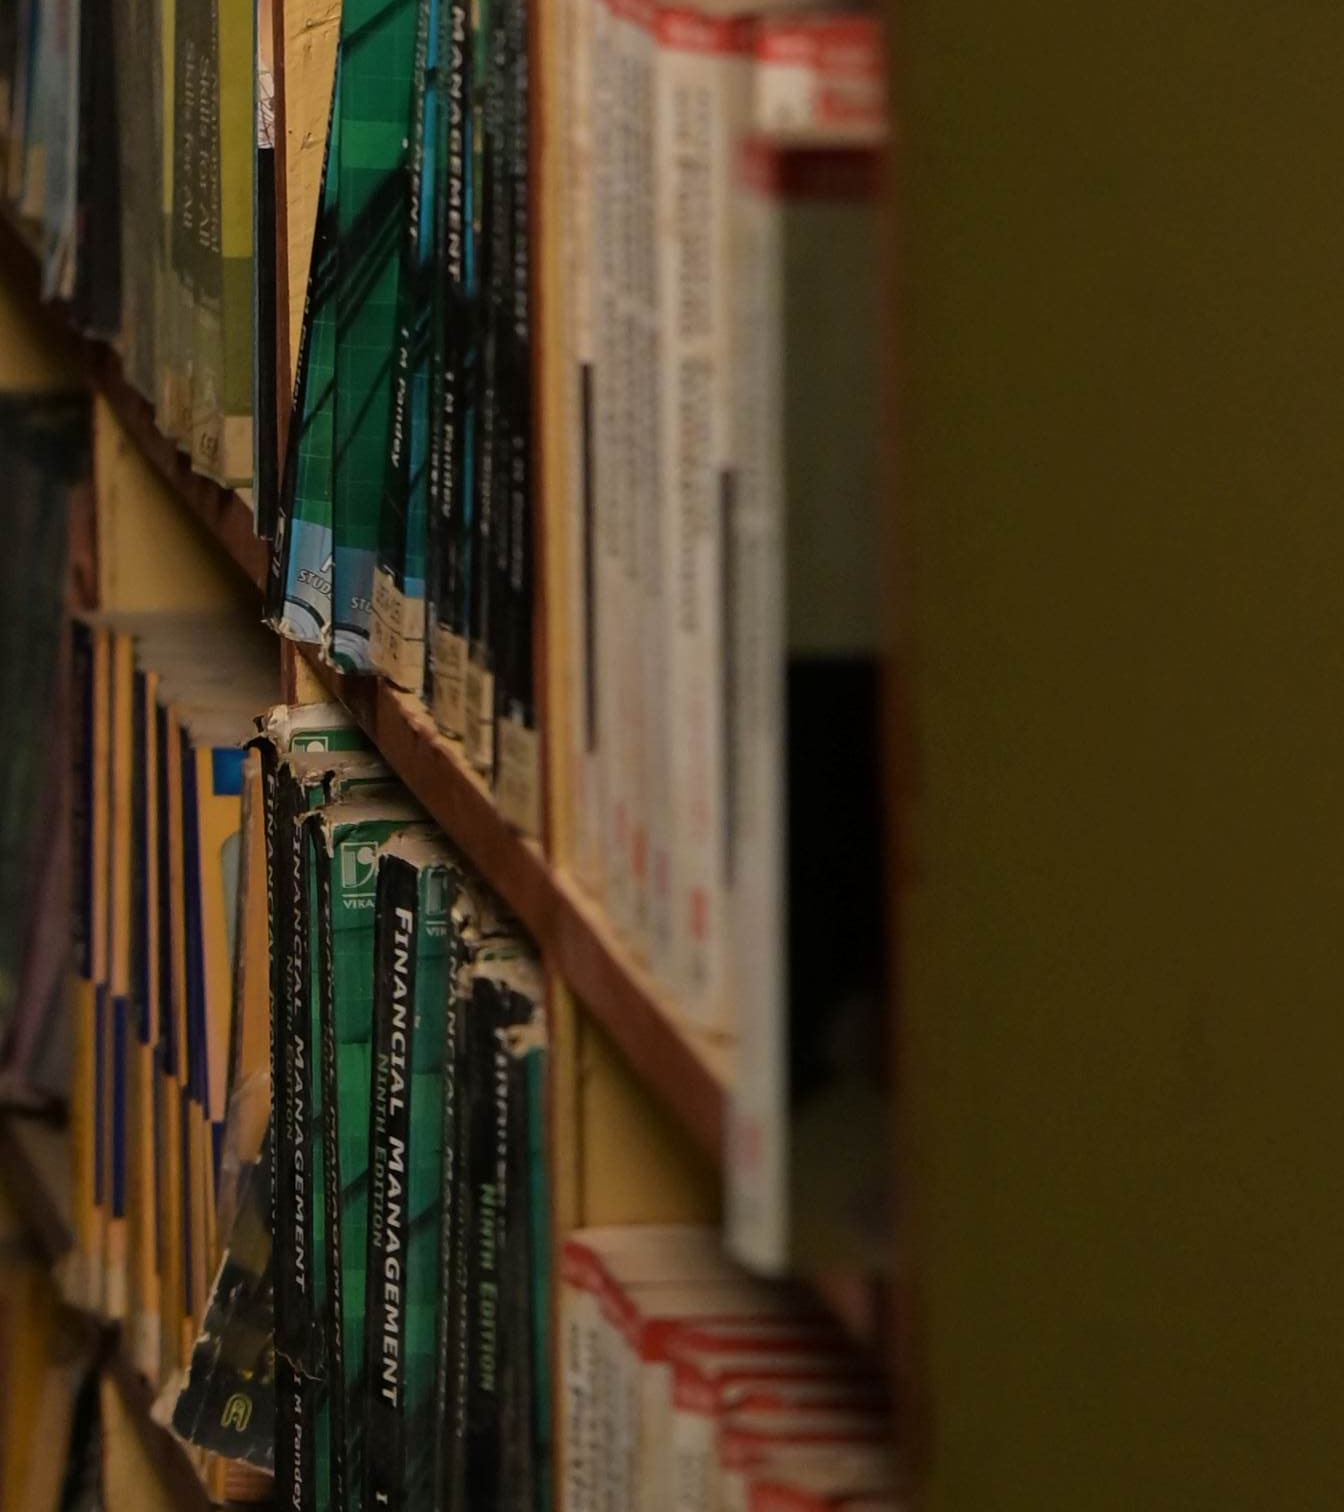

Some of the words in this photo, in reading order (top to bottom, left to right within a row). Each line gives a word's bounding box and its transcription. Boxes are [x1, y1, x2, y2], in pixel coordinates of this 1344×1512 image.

[448, 5, 465, 282] MANAGEMENT
[391, 378, 407, 468] Pandey
[293, 815, 304, 1015] FINANCIAL
[343, 899, 376, 910] VIKA
[388, 906, 413, 1116] FINANCIAL
[374, 1053, 388, 1140] NINTH
[293, 1034, 306, 1294] MANAGEMENT
[372, 1145, 387, 1249] EDITION
[381, 1135, 406, 1408] MANAGEMENT
[479, 1182, 498, 1272] NINTH
[478, 1280, 499, 1392] EDITION
[292, 1392, 302, 1414] M
[291, 1422, 302, 1511] Pandey
